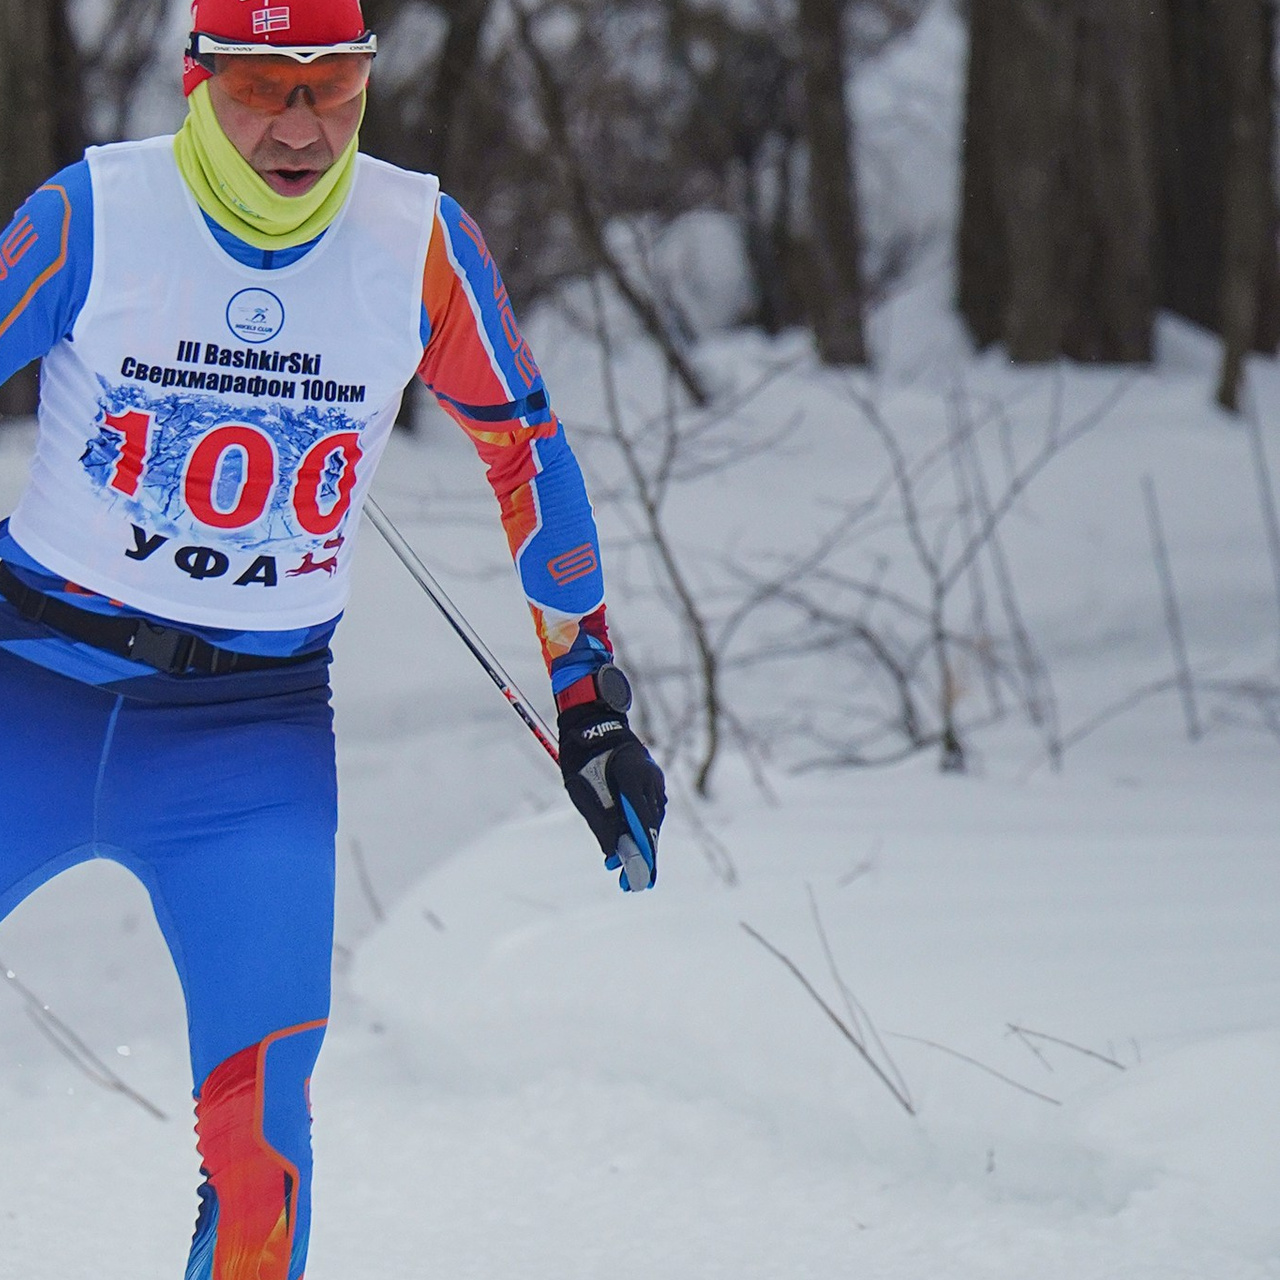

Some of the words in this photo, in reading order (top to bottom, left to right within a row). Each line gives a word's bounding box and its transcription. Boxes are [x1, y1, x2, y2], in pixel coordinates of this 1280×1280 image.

[120, 356, 297, 399] Сверхмарафон
[300, 379, 366, 403] 100км
[176, 340, 201, 364] III
[203, 343, 322, 376] BashkirSki
[103, 410, 363, 535] 100
[124, 523, 278, 587] УФА
